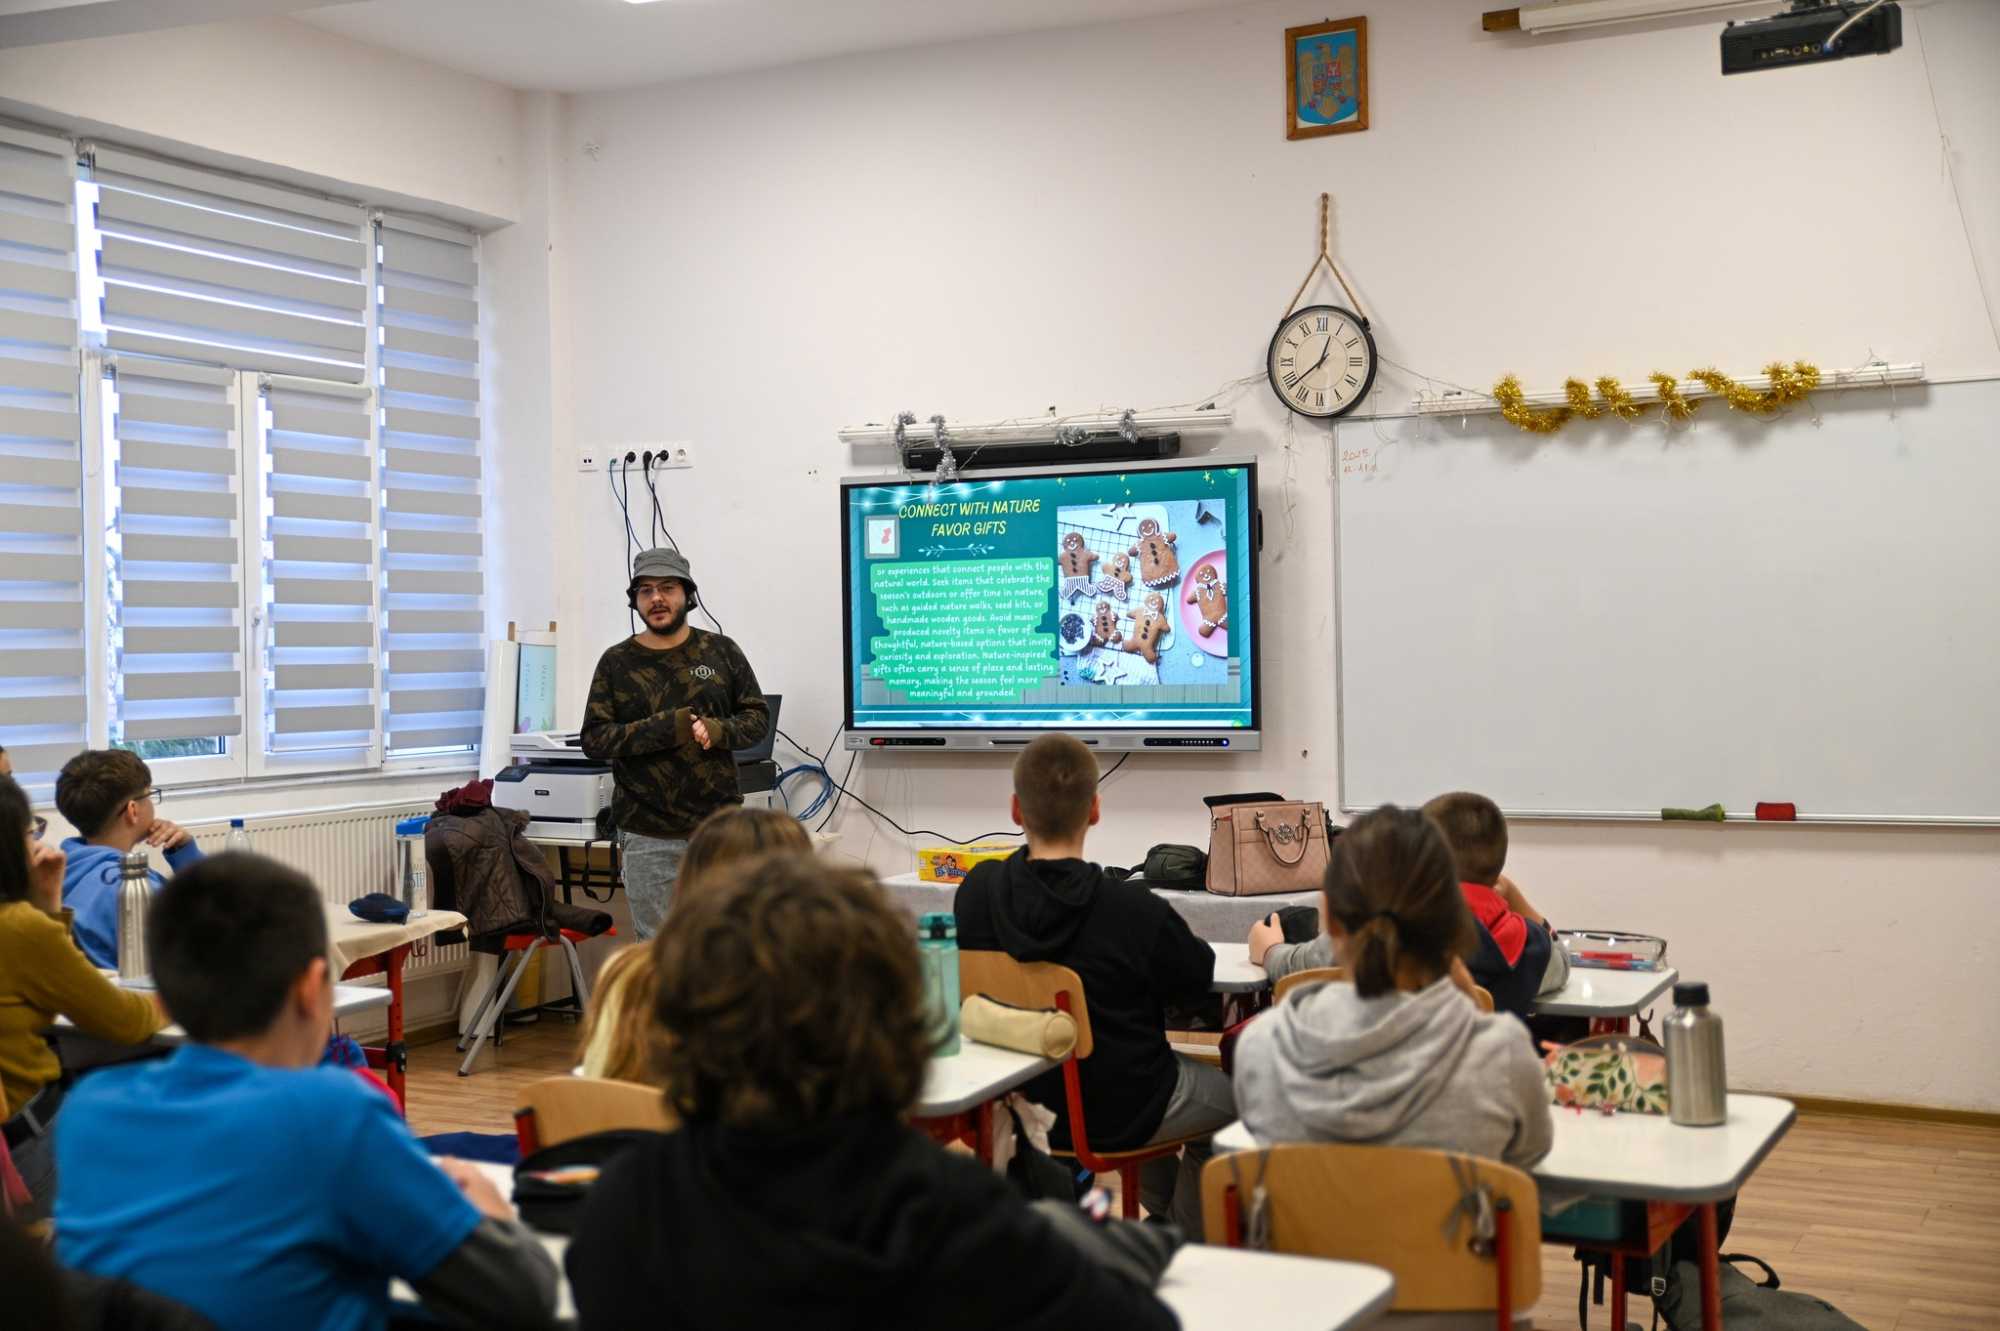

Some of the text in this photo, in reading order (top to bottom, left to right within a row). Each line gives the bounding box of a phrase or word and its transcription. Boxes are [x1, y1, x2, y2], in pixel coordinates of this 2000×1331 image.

[1299, 321, 1311, 338] XI
[1316, 317, 1328, 332] XII
[1335, 322, 1344, 336] I
[1285, 337, 1299, 349] X
[1345, 337, 1359, 349] II
[1280, 357, 1294, 367] IX
[1349, 357, 1363, 367] III
[1295, 386, 1310, 403] VII
[1315, 392, 1324, 406] VI
[1334, 388, 1342, 401] V
[899, 498, 1041, 519] CONNECT WITH NATURE
[931, 520, 1007, 537] FAVOR GIFTS
[887, 566, 930, 578] experiences
[933, 564, 950, 574] that
[952, 564, 984, 573] connect
[987, 561, 1012, 576] people
[1015, 561, 1034, 571] with
[1036, 560, 1050, 571] the
[874, 577, 904, 588] natural
[951, 576, 973, 586] items
[976, 575, 993, 585] that
[995, 574, 1033, 584] celebrate
[1036, 574, 1050, 583] the
[912, 590, 948, 600] outdoors
[949, 591, 958, 599] or
[960, 588, 981, 600] offer
[1003, 588, 1012, 597] in
[881, 602, 898, 612] such
[911, 602, 938, 615] guided
[940, 602, 967, 611] nature
[995, 600, 1012, 609] seed
[1034, 601, 1043, 609] or
[887, 615, 929, 624] handmade
[931, 614, 960, 623] wooden
[893, 623, 1032, 640] produced novelty items in favor of
[976, 638, 1005, 651] options
[1008, 637, 1026, 647] that
[1028, 637, 1052, 646] invite
[880, 653, 913, 664] curiosity
[915, 651, 931, 660] and
[873, 663, 891, 677] gifts
[894, 663, 915, 675] often
[917, 666, 939, 678] carry
[949, 665, 970, 673] sense
[971, 662, 981, 674] of
[983, 662, 1004, 675] place
[1006, 661, 1023, 671] and
[1025, 659, 1054, 674] lasting
[924, 676, 953, 689] making
[955, 675, 970, 684] the
[1000, 674, 1015, 686] feel
[910, 688, 954, 700] meaningful
[957, 688, 972, 697] and
